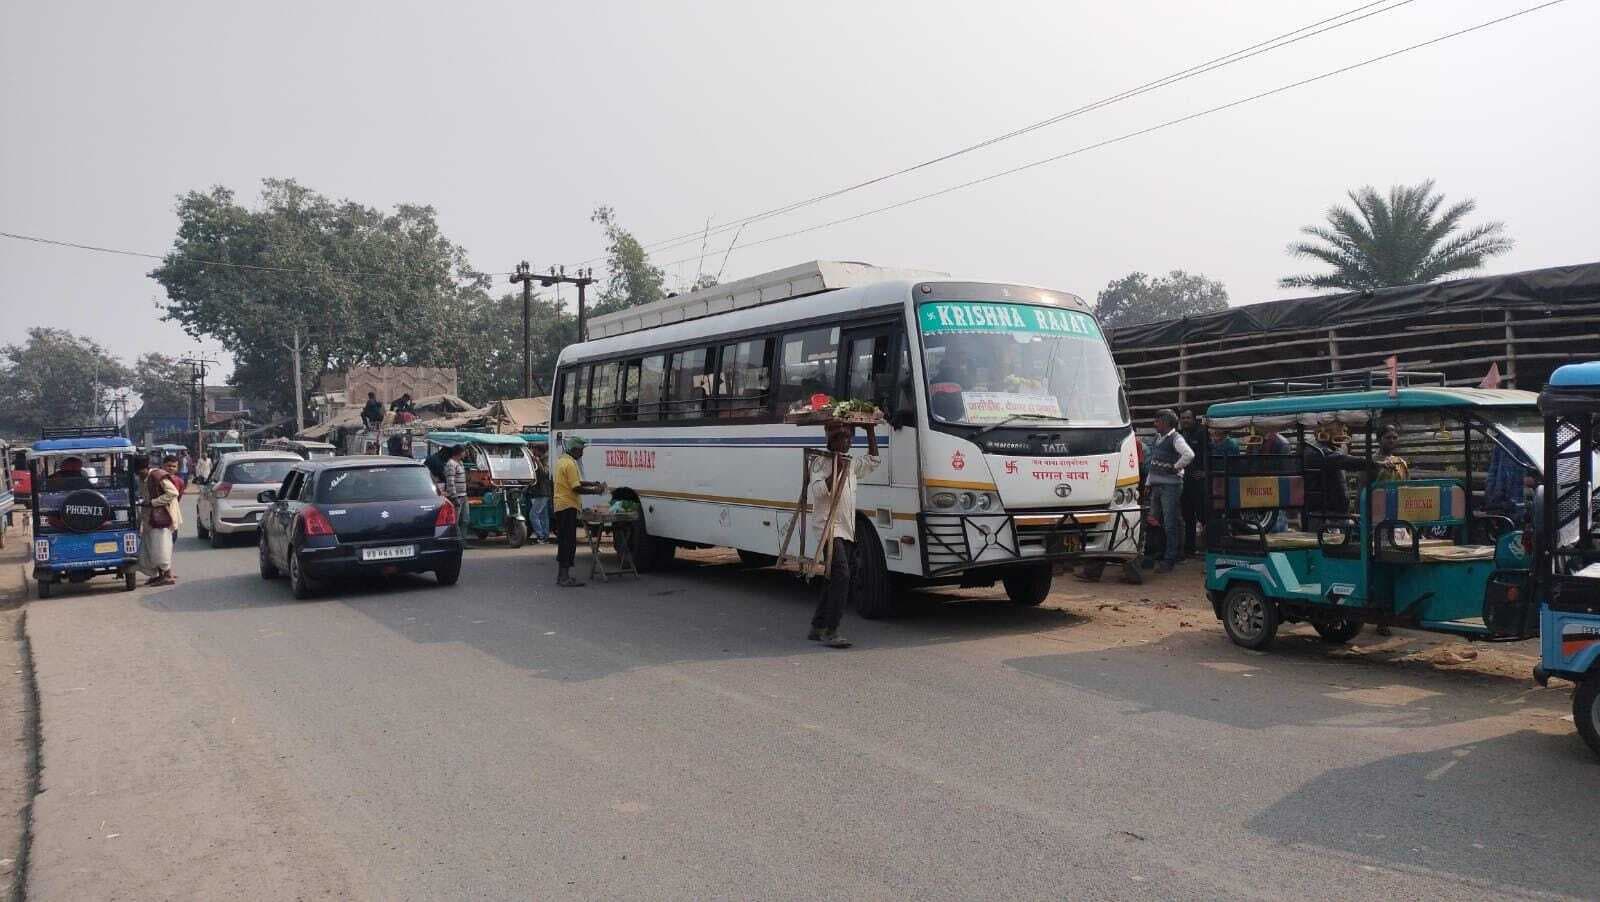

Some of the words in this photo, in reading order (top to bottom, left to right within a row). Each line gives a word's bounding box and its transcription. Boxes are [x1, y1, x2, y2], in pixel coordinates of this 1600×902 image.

[936, 305, 1026, 329] KRISHNA
[1033, 309, 1090, 334] RAJAT
[1041, 443, 1069, 453] TATA
[606, 450, 633, 467] KRISHNA
[634, 450, 656, 468] RAJAT
[1032, 471, 1062, 480] पागल
[1066, 471, 1089, 480] बाबा
[65, 504, 105, 516] PHOENIX
